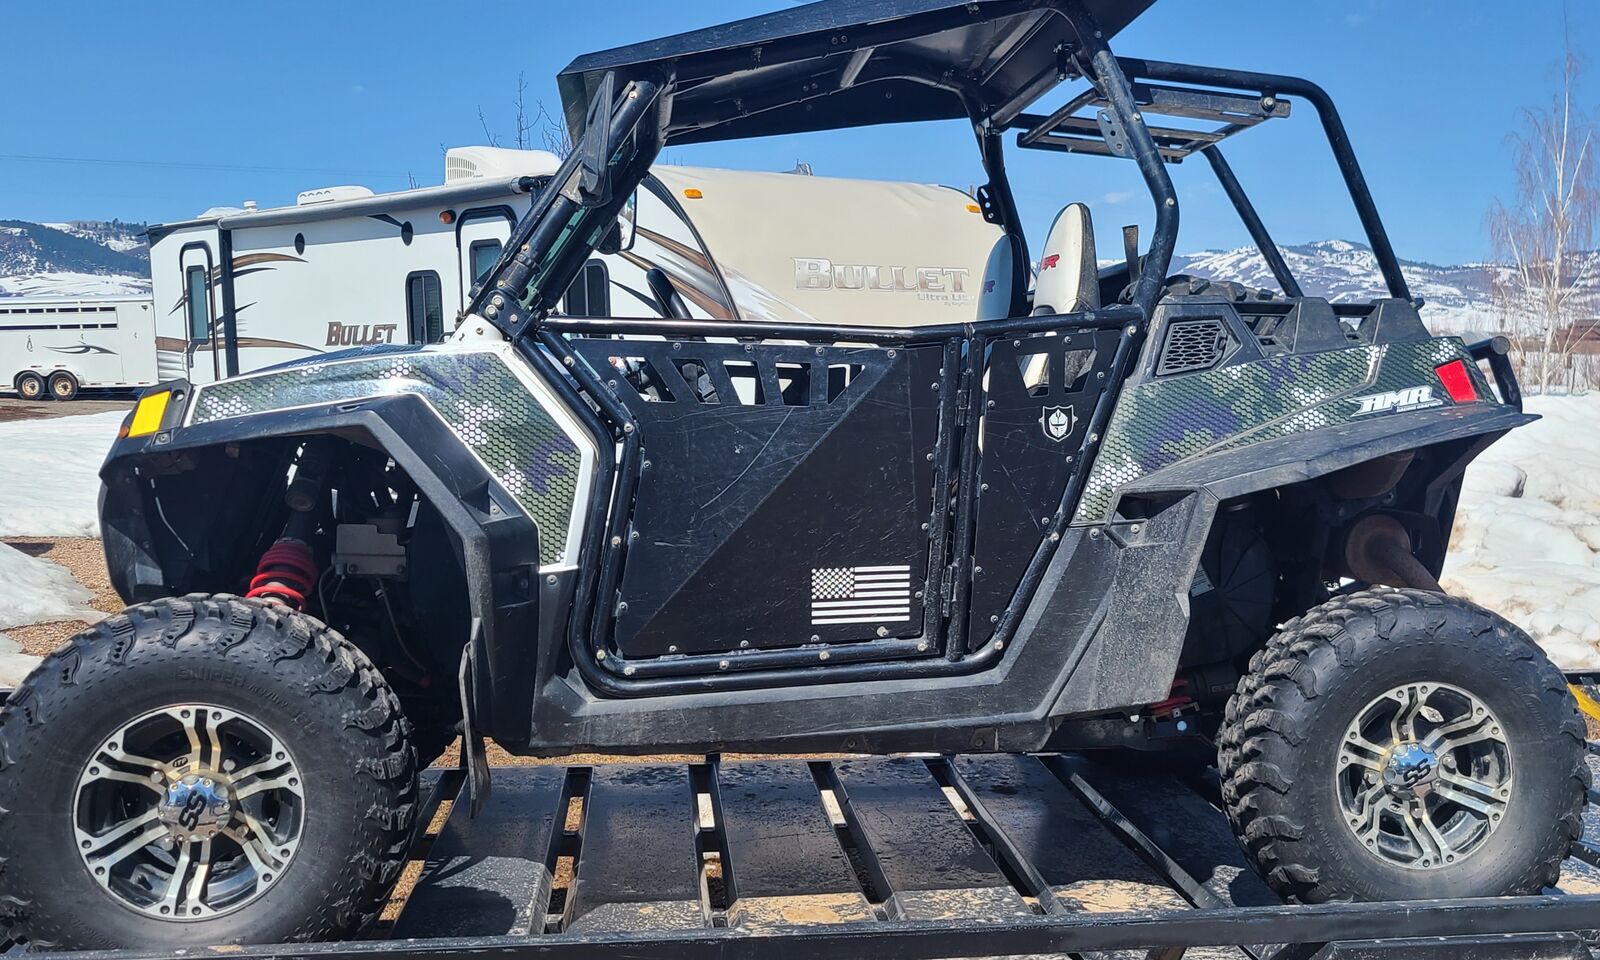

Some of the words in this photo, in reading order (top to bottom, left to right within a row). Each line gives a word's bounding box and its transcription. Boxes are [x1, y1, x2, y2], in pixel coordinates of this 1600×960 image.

[793, 257, 970, 293] BULLET
[325, 321, 398, 347] BULLET
[1344, 385, 1440, 417] AMR
